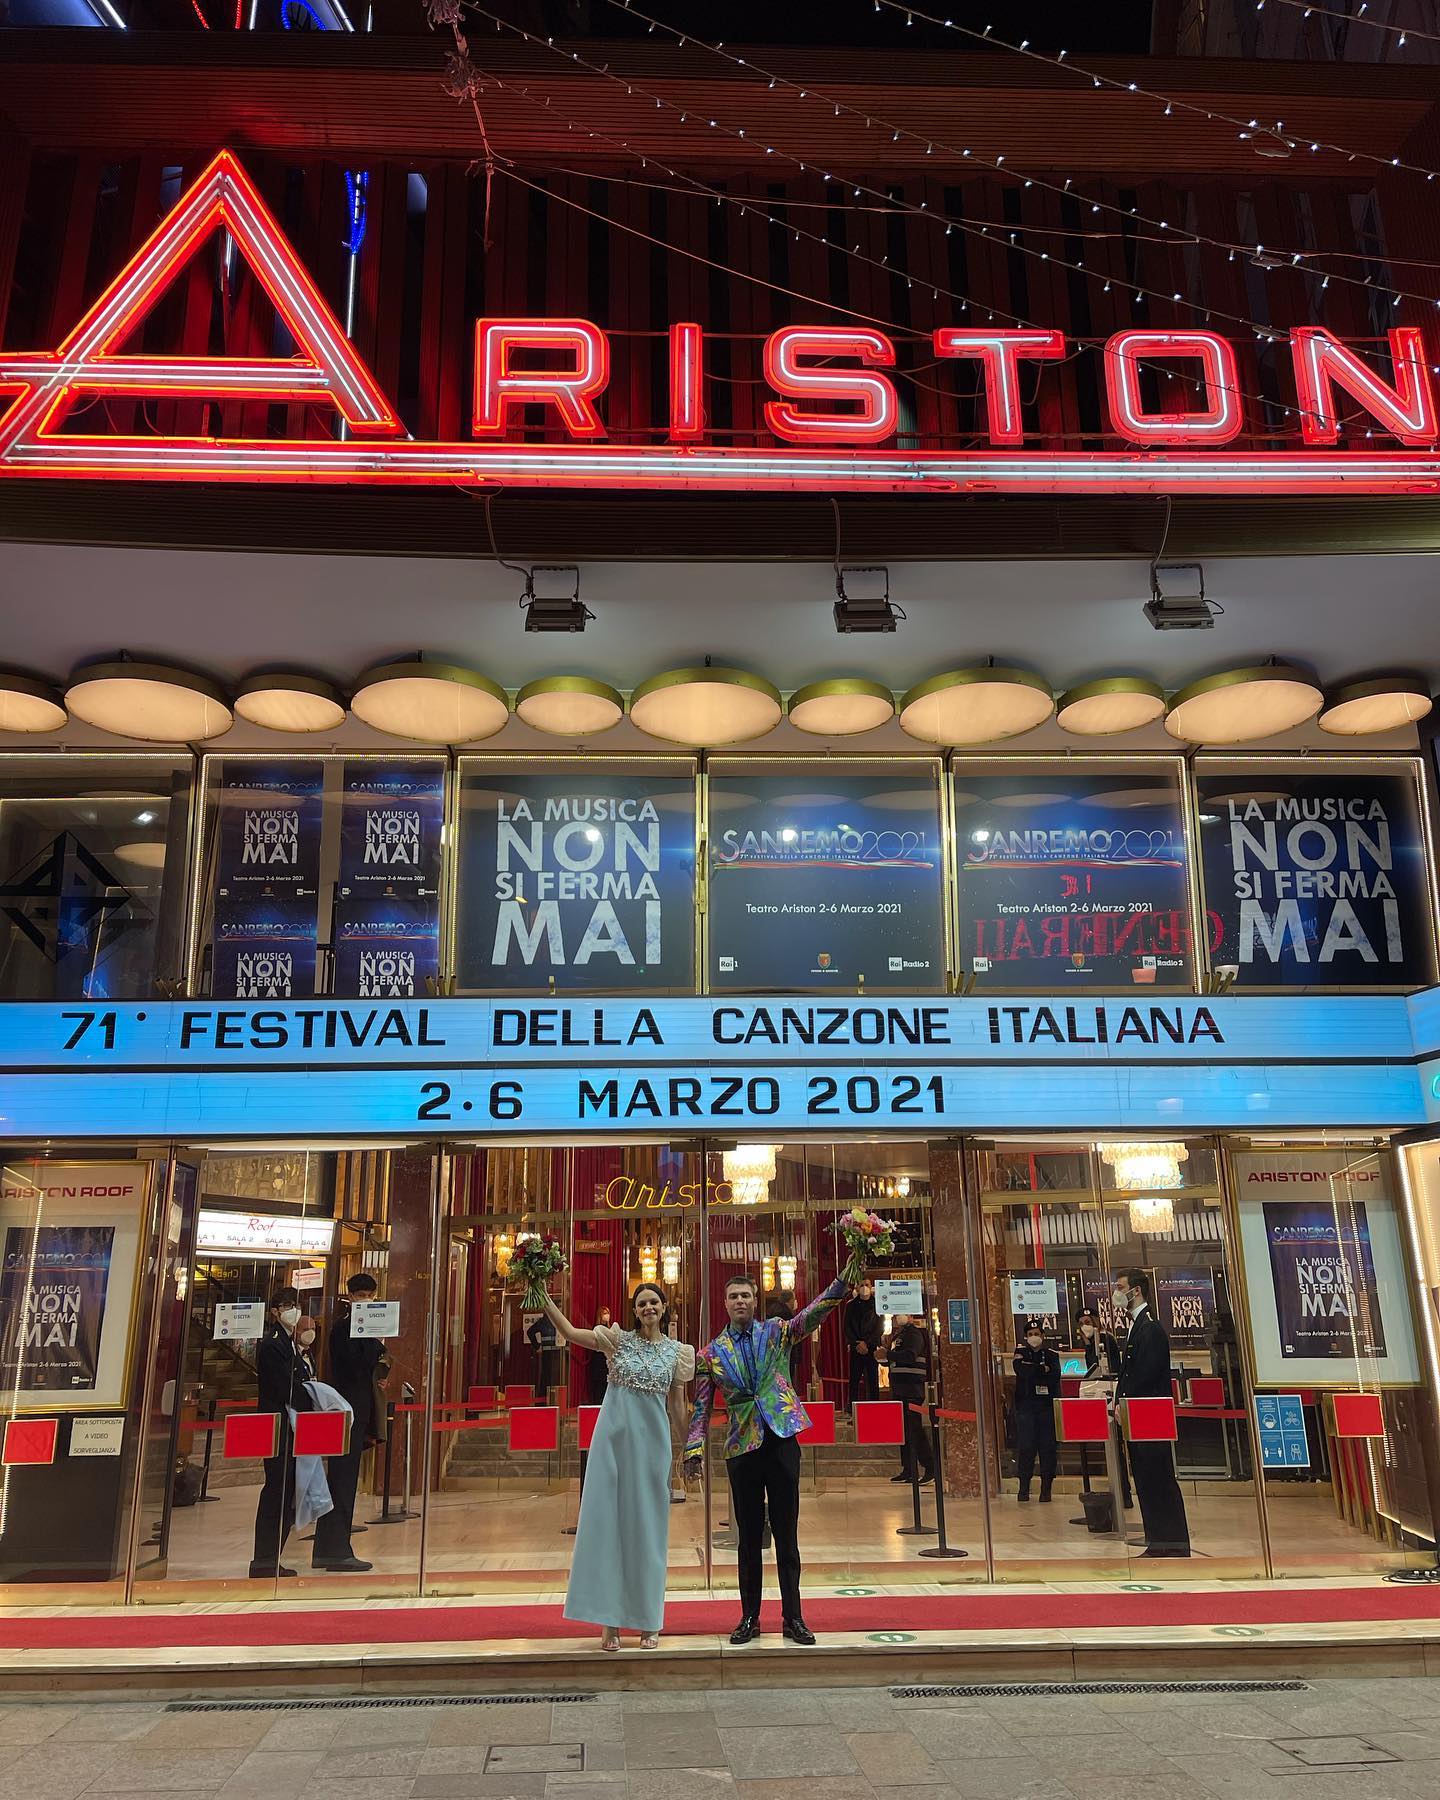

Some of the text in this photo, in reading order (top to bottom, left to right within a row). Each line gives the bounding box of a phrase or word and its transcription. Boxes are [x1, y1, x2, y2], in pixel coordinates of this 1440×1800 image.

[0, 148, 1440, 458] ARISTON
[498, 799, 659, 821] LA MUSICA
[1228, 798, 1387, 820] LA MUSICA
[244, 818, 298, 834] NON
[366, 818, 419, 834] NON
[244, 834, 297, 843] SI FERMA
[365, 834, 418, 843] SI FERMA
[496, 821, 660, 872] NON
[1230, 821, 1392, 871] NON
[242, 843, 298, 864] MAI
[364, 843, 419, 864] MAI
[495, 872, 660, 900] SI FERMA
[1234, 871, 1396, 898] SI FERMA
[746, 904, 901, 913] Teatro Ariston 2-6 Marzo 2021
[997, 903, 1153, 913] Teatro Ariston 2-6 Marzo 2021
[492, 900, 661, 965] MAI
[1238, 899, 1404, 963] MAI
[376, 952, 414, 960] MUSICA
[237, 960, 292, 977] NON
[360, 960, 414, 976] NON
[236, 977, 291, 986] SI FERMA
[359, 976, 414, 985] SI FERMA
[180, 1008, 446, 1049] FESTIVAL
[493, 1008, 665, 1046] DELLA
[712, 1007, 951, 1045] CANZONE
[989, 1006, 1225, 1044] ITALIANA
[578, 1077, 780, 1118] MARZO
[807, 1075, 945, 1114] 2021
[1248, 1172, 1326, 1182] ARISTON
[0, 1186, 134, 1198] RISTON ROOF
[247, 1218, 277, 1233] Roof
[1296, 1266, 1353, 1284] NON
[40, 1285, 81, 1294] MUSICA
[1300, 1284, 1354, 1294] SI FERMA
[21, 1294, 81, 1312] NON
[1171, 1300, 1202, 1310] NON
[1302, 1294, 1358, 1316] MAI
[34, 1313, 78, 1323] FERMA
[1173, 1316, 1204, 1328] MAI
[15, 1323, 78, 1347] MAI
